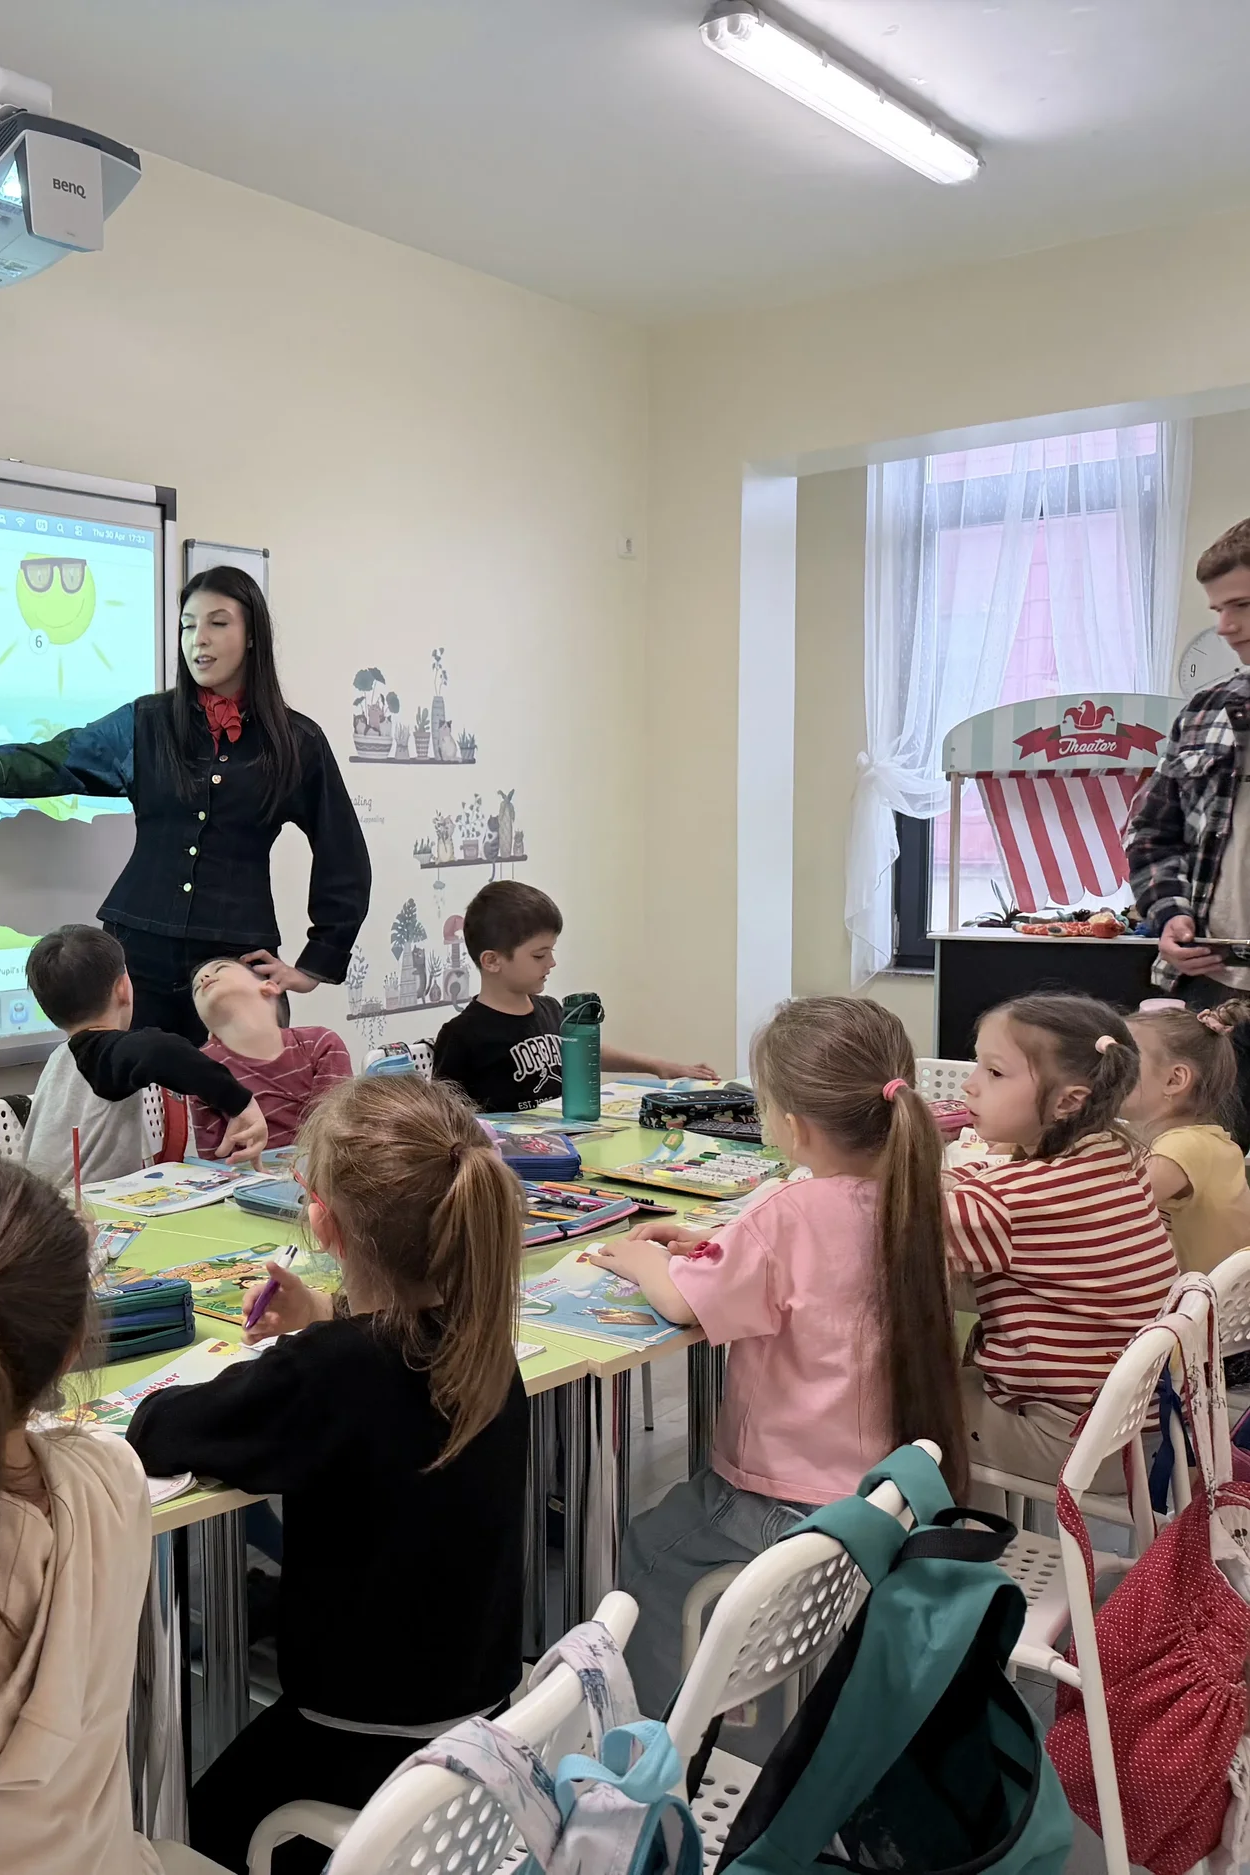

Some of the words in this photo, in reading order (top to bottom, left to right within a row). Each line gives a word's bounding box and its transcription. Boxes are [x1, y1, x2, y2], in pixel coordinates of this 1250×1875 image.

[52, 178, 86, 199] BenQ
[92, 528, 104, 538] Thu
[35, 635, 43, 648] 6
[1190, 664, 1196, 678] 9
[1059, 737, 1117, 755] Theater
[510, 1034, 562, 1082] JORDA
